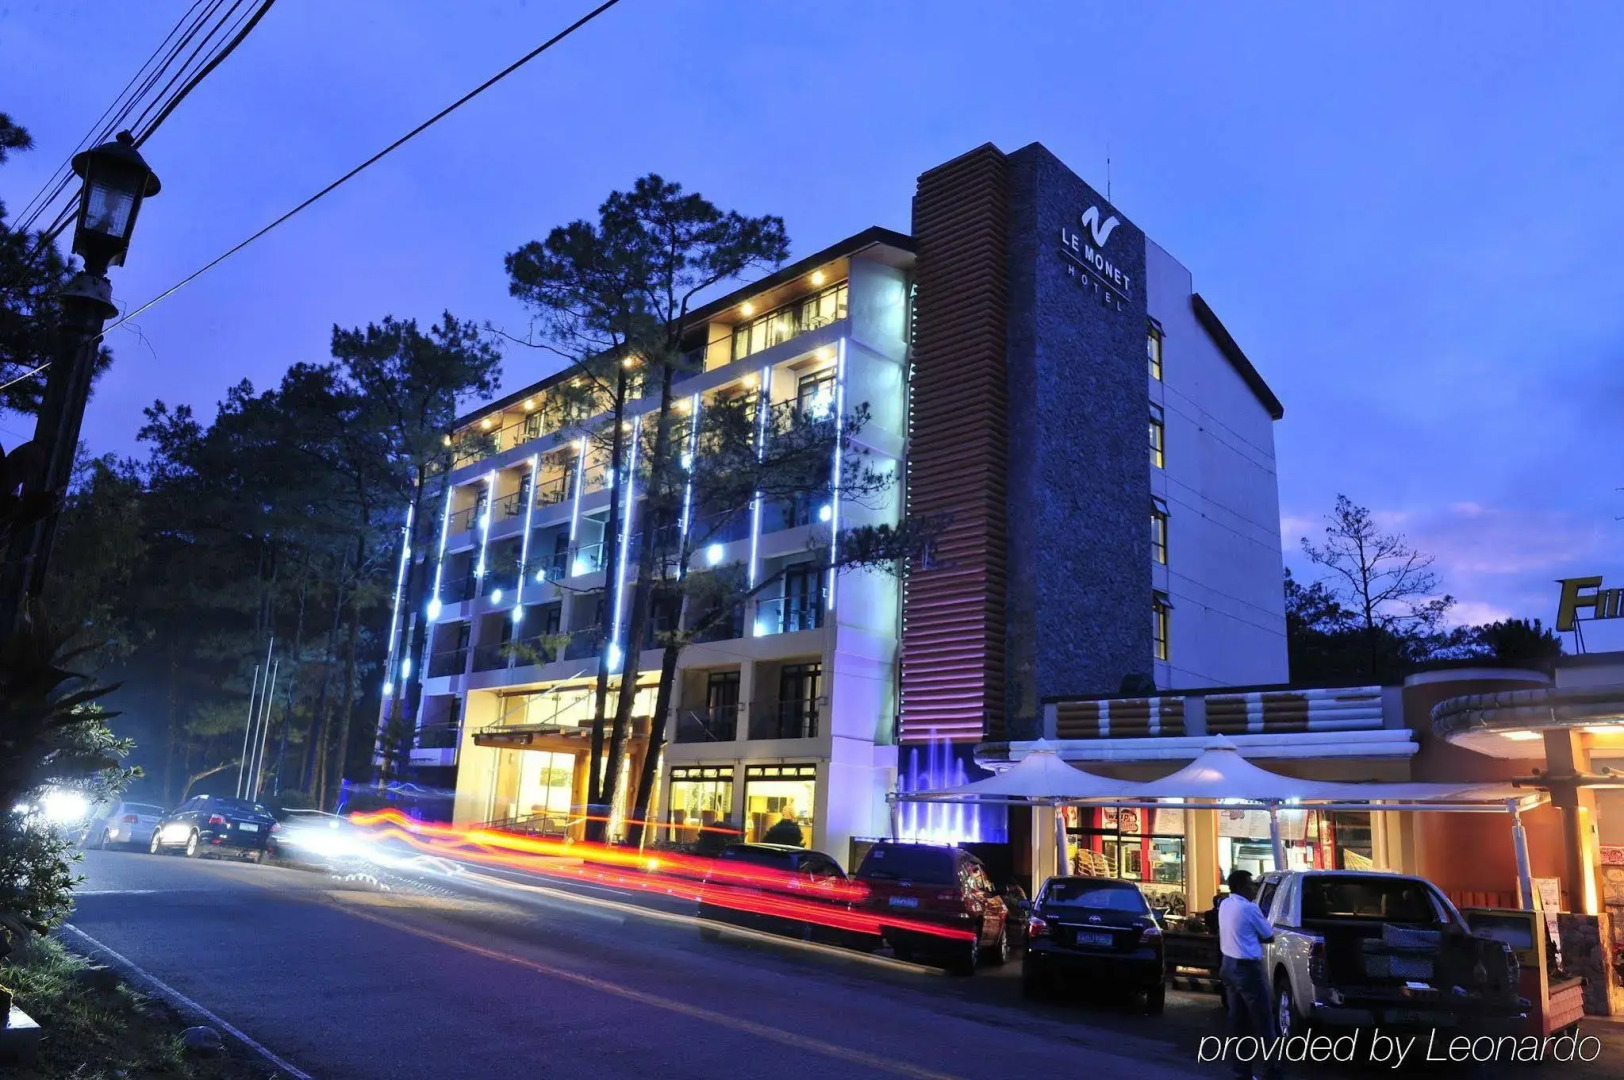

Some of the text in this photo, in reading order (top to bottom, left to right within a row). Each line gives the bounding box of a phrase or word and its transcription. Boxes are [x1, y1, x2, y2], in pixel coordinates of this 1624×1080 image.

[1062, 227, 1130, 290] LE MONET
[1068, 264, 1122, 312] HOTEL
